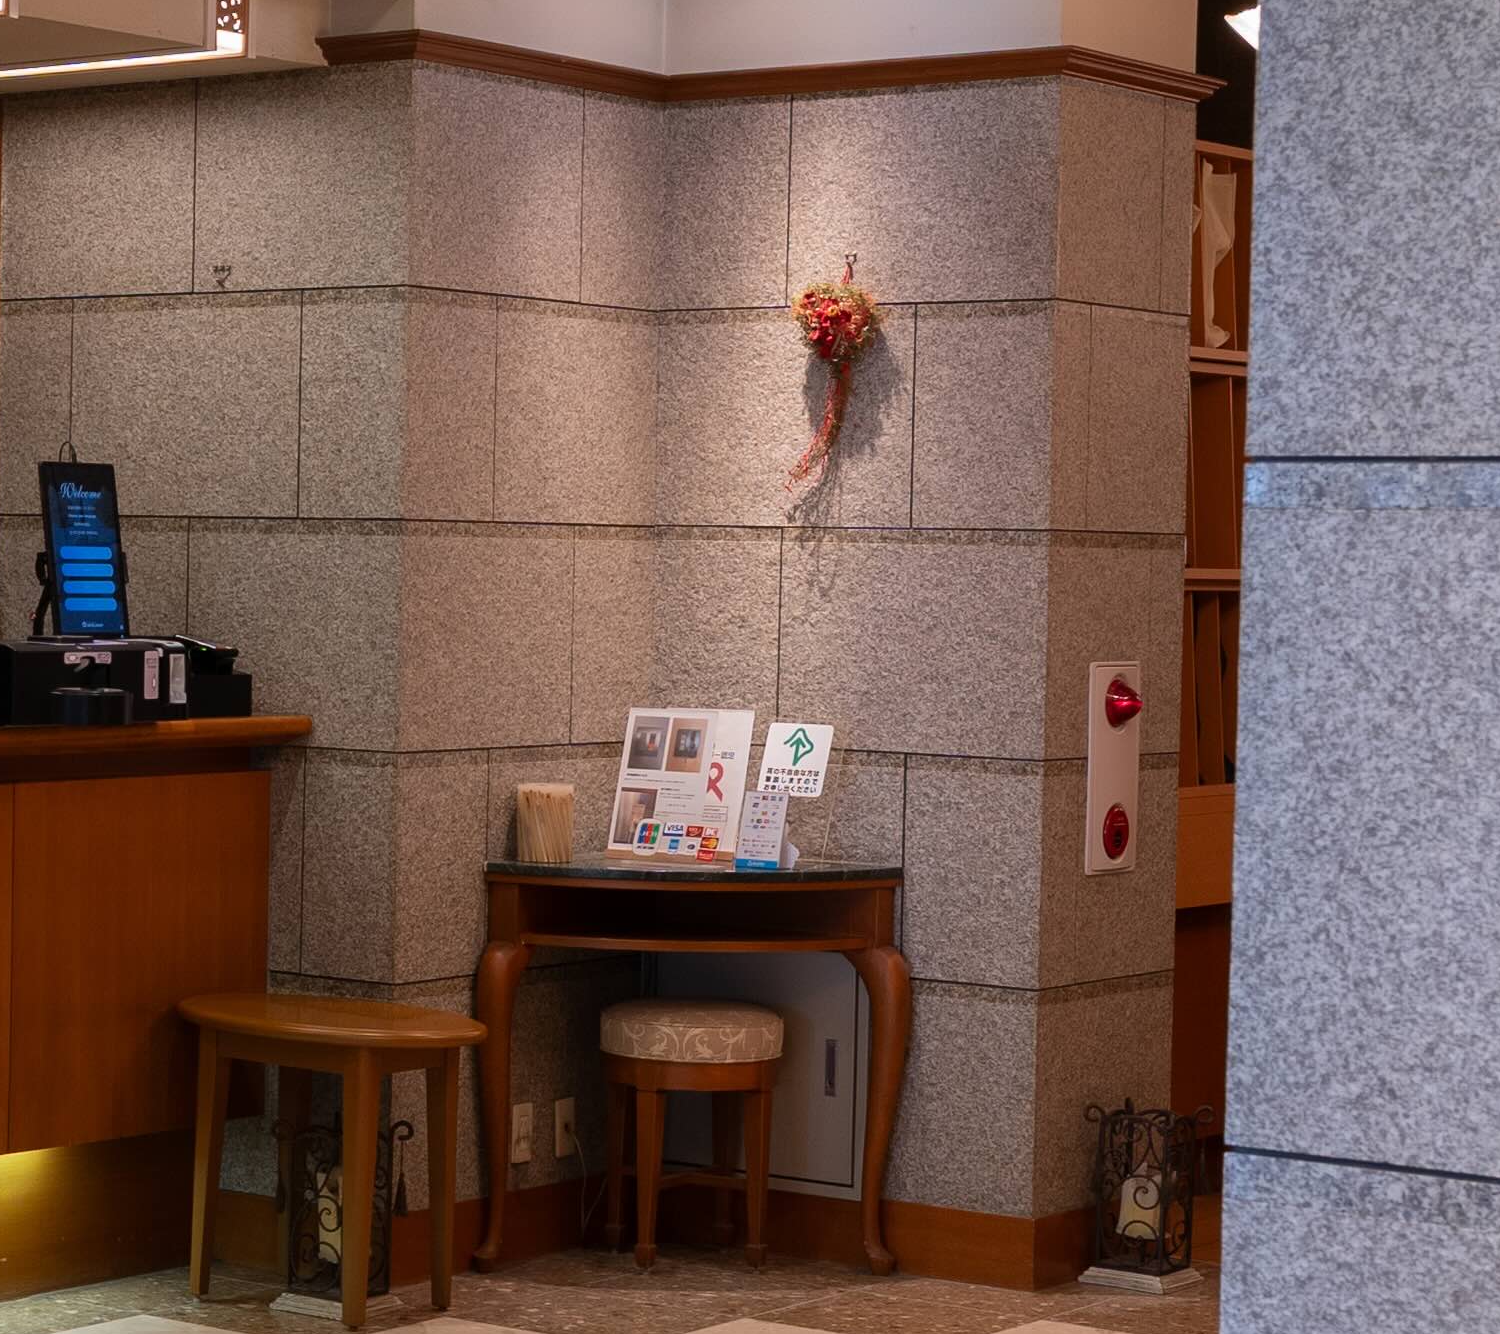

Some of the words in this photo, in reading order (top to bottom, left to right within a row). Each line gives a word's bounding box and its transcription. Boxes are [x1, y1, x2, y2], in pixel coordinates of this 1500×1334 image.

[59, 482, 102, 499] Welcome
[766, 767, 820, 777] 耳の不自由な方は
[667, 824, 684, 832] VISA
